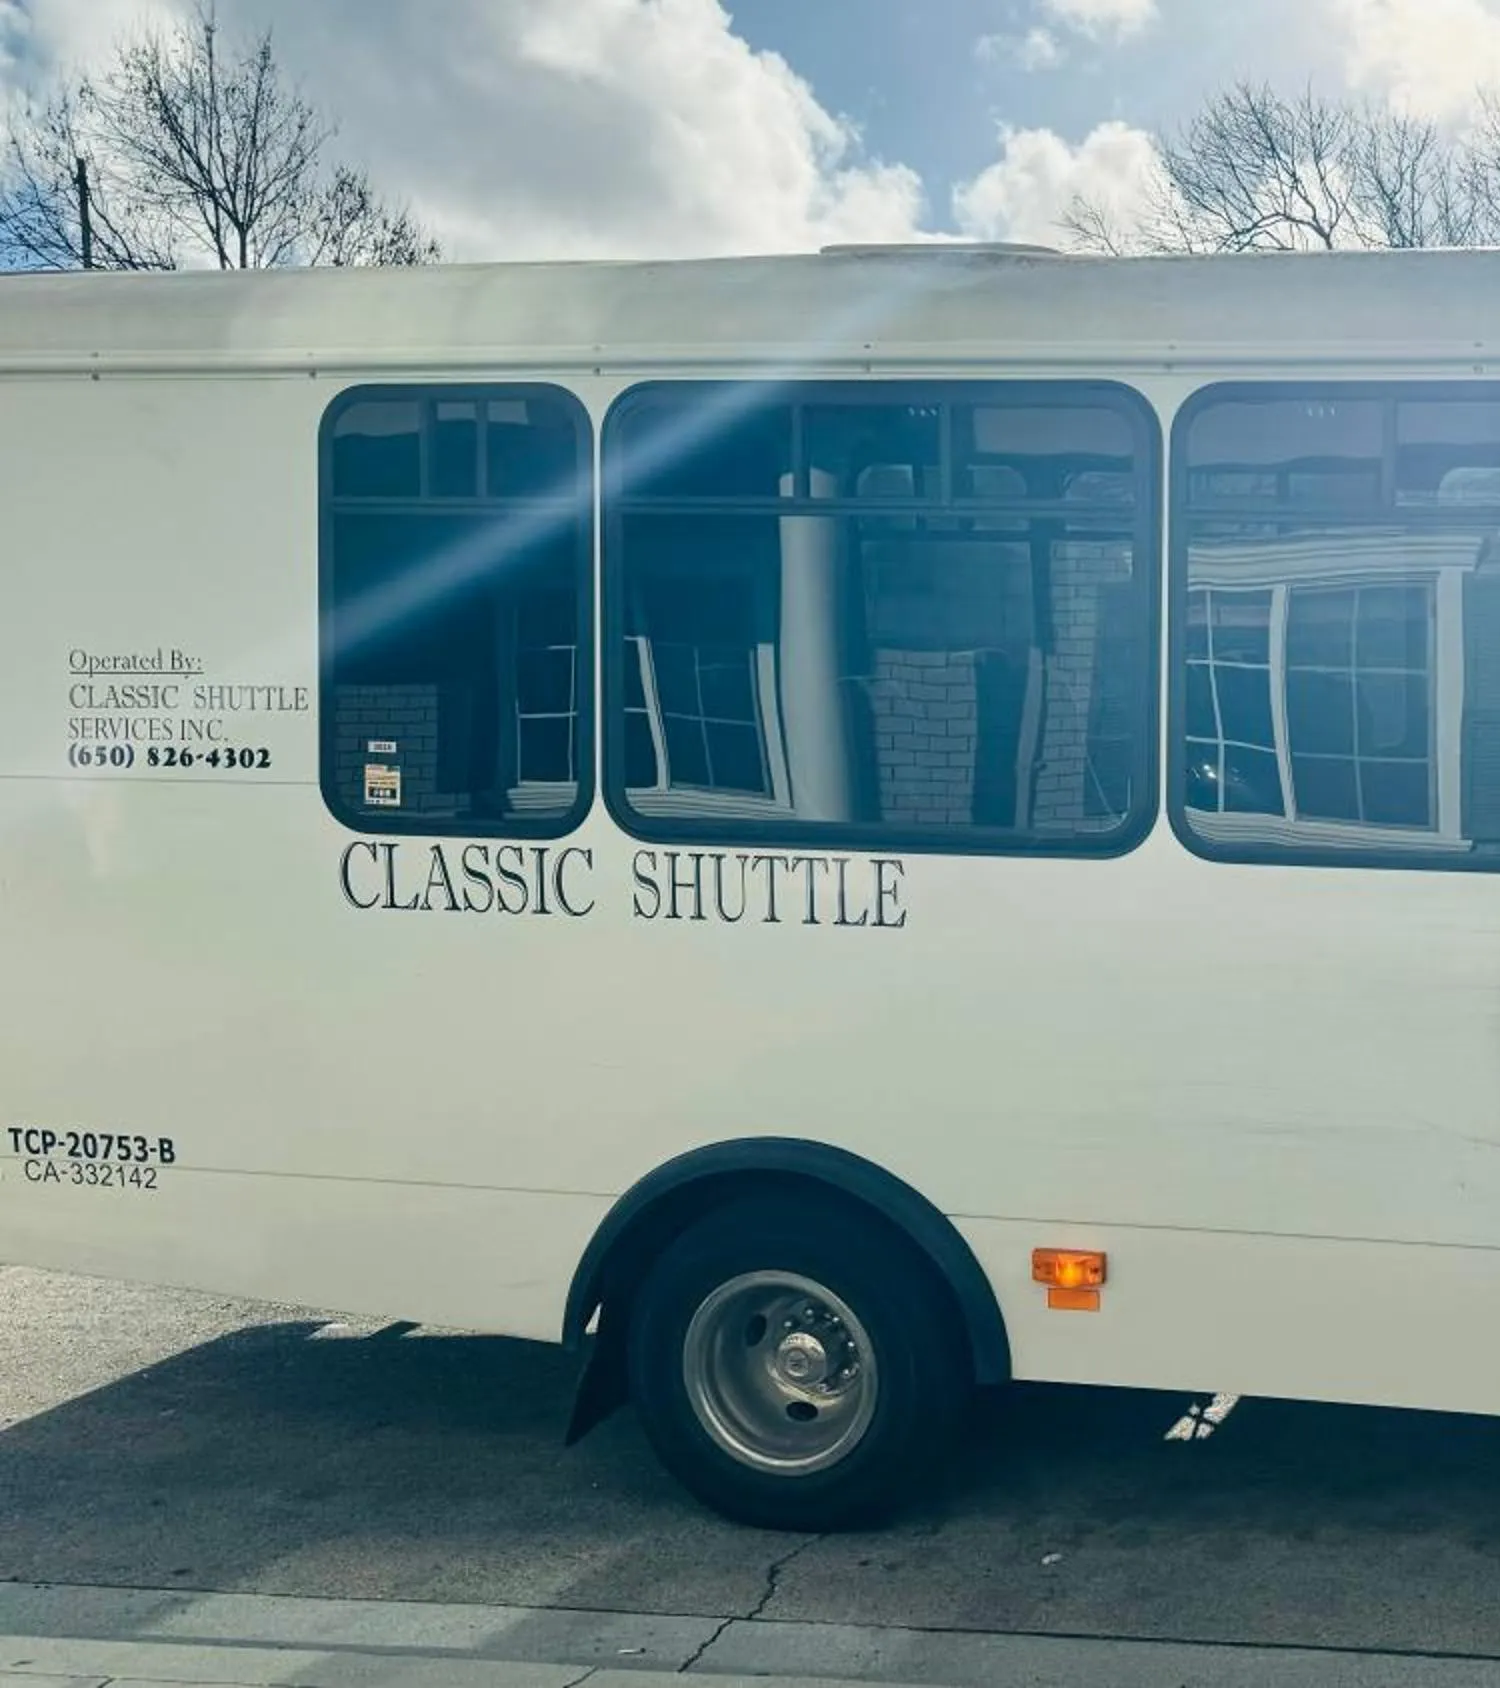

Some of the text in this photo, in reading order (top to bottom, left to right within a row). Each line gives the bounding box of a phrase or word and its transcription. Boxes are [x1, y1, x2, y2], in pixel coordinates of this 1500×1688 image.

[69, 648, 202, 678] Operated By:
[68, 684, 309, 711] CLASSIC SHUTTLE
[67, 716, 230, 742] SERVICES INC.
[68, 743, 272, 769] (650) 826-4302
[339, 840, 907, 929] CLASSIC SHUTTLE
[7, 1126, 176, 1164] TCP-20753-B
[24, 1159, 158, 1190] CA-332142
